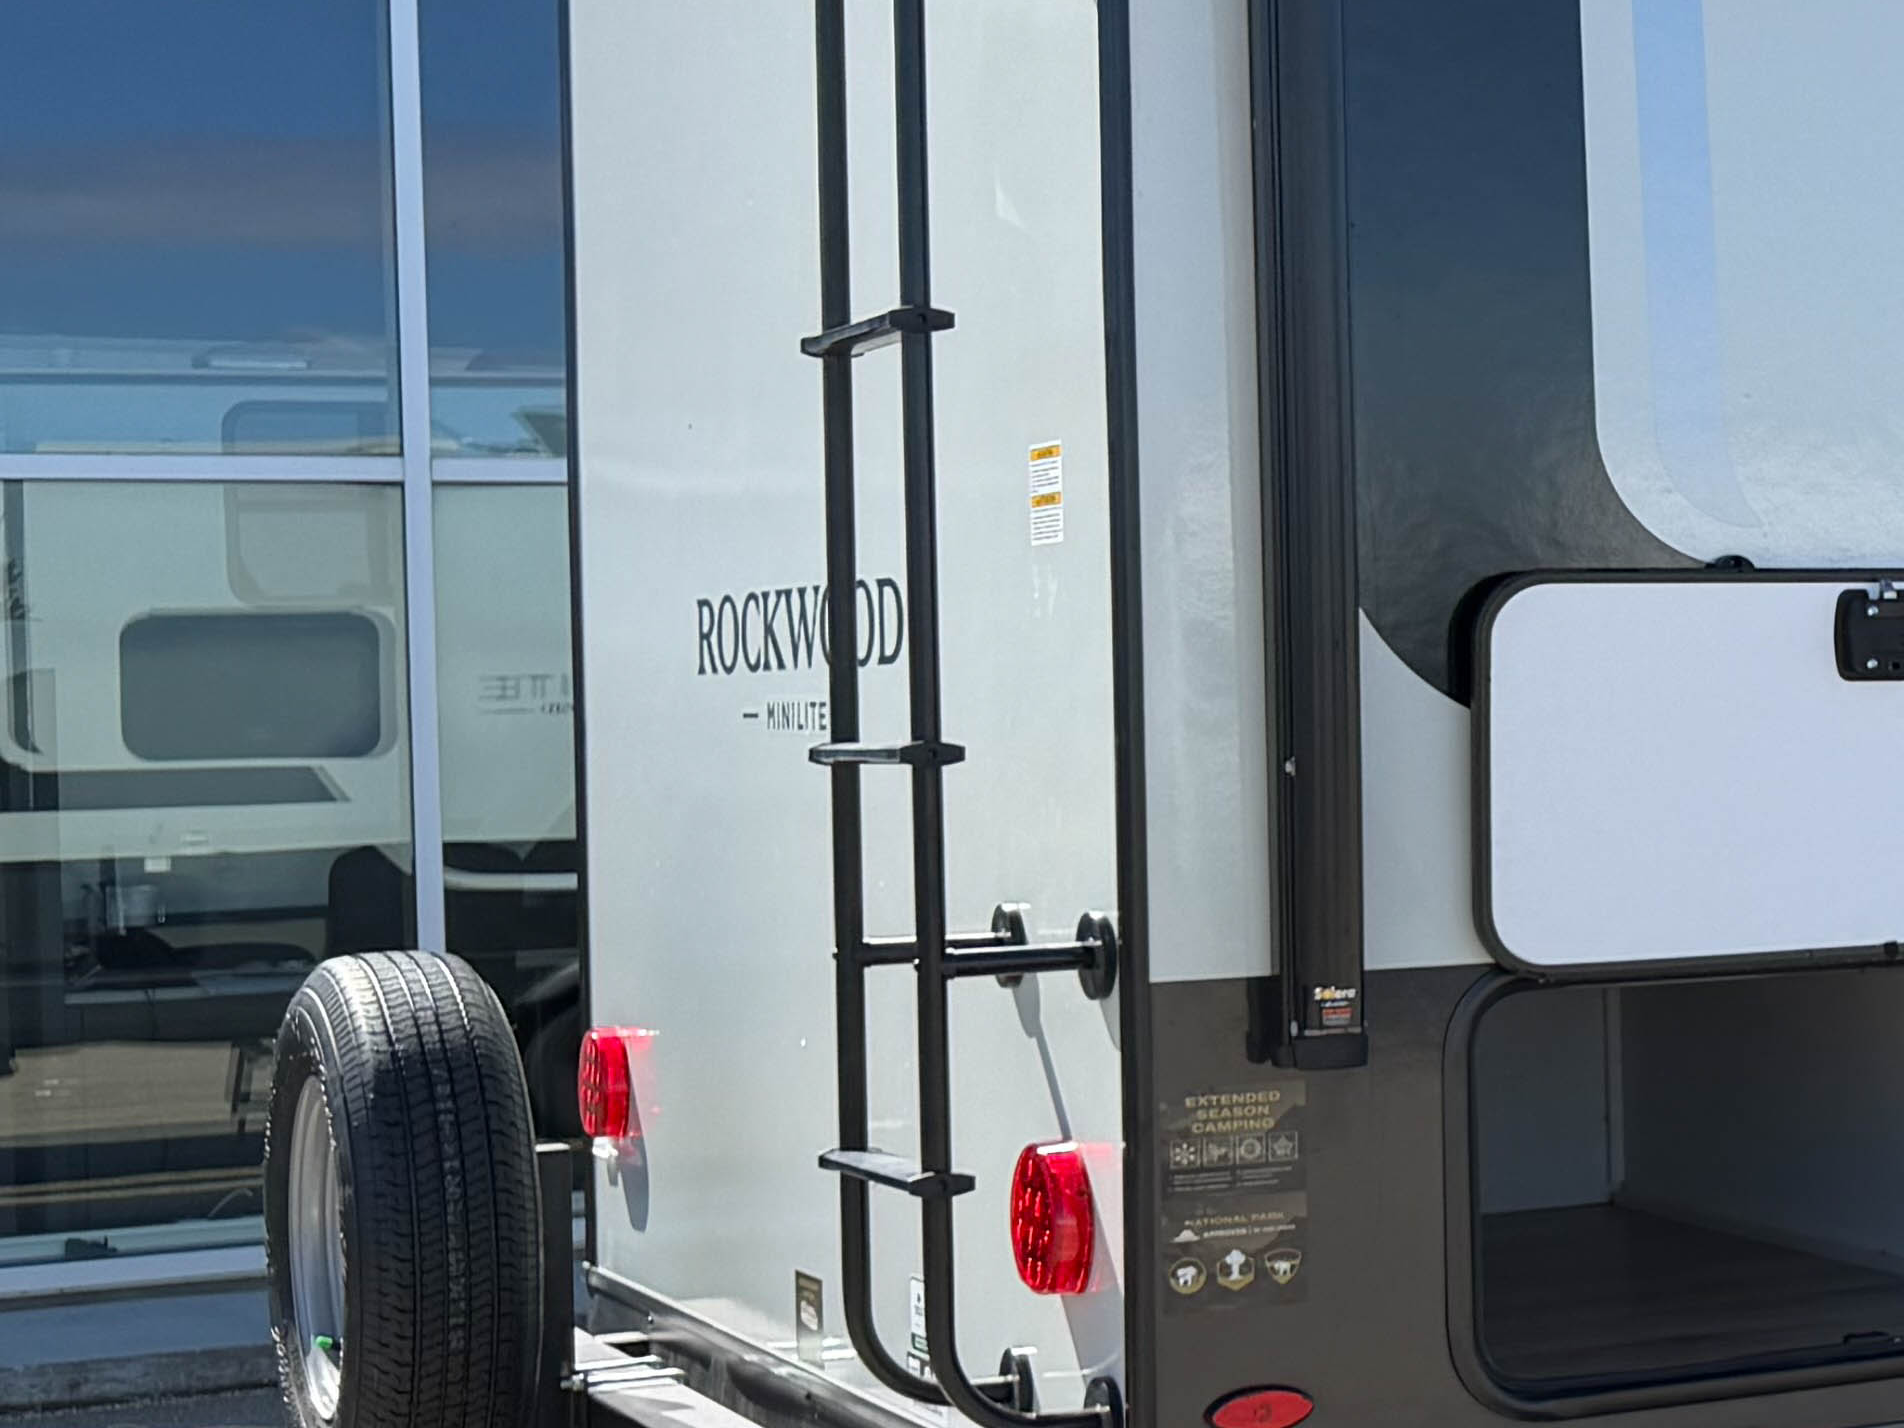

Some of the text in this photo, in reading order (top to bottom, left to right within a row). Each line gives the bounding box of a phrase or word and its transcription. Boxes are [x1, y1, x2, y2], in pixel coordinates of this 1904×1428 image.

[767, 701, 827, 731] MINILITE
[1184, 1090, 1281, 1108] EXTENDED
[1196, 1105, 1270, 1121] SEASON
[1191, 1117, 1276, 1134] CAMPING
